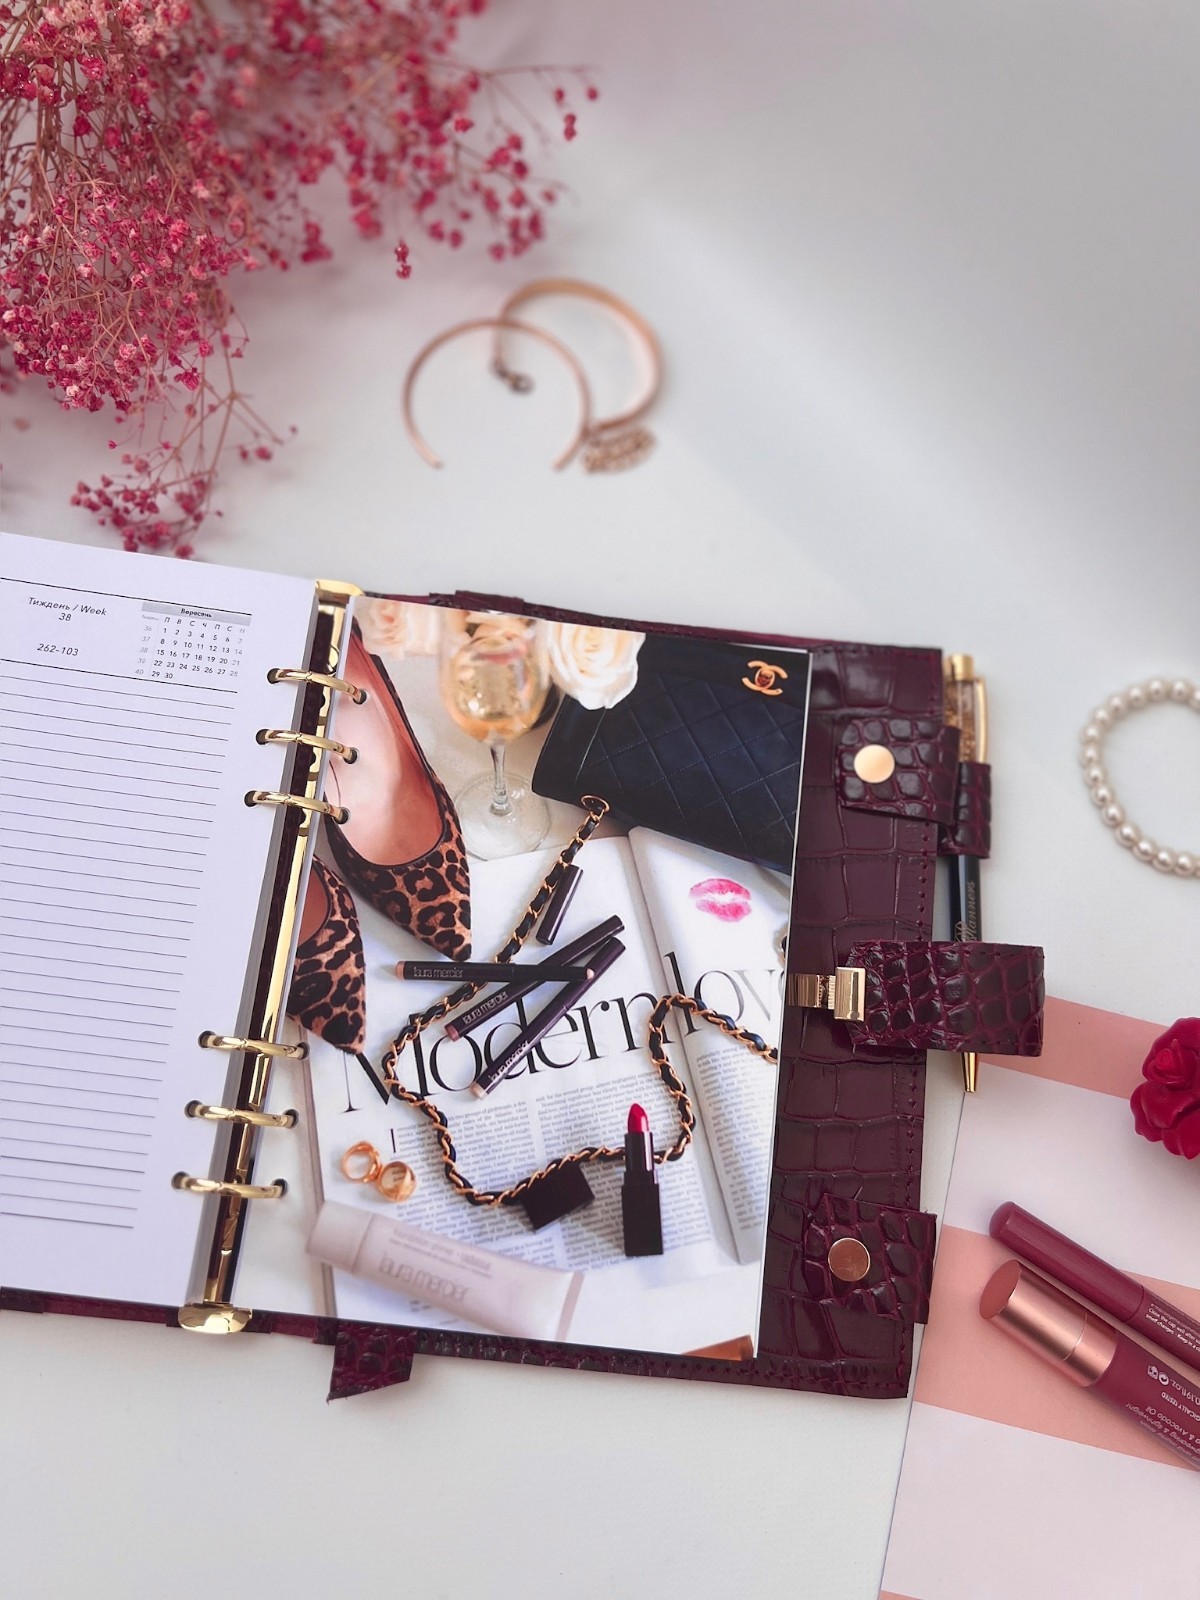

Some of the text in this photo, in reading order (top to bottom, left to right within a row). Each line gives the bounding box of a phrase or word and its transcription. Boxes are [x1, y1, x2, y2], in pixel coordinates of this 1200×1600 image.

[28, 596, 70, 611] Тиждень
[80, 604, 107, 616] Week
[180, 607, 212, 618] Вересень
[58, 612, 72, 622] 38
[36, 643, 79, 657] 262-103
[413, 966, 464, 979] laura mercier
[462, 991, 509, 1025] laura mercier
[343, 951, 785, 1112] Modern lov
[1161, 1391, 1178, 1407] TESTED
[1125, 1402, 1163, 1430] lightweight
[1145, 1405, 1157, 1416] Oil
[1157, 1413, 1189, 1436] Avocado
